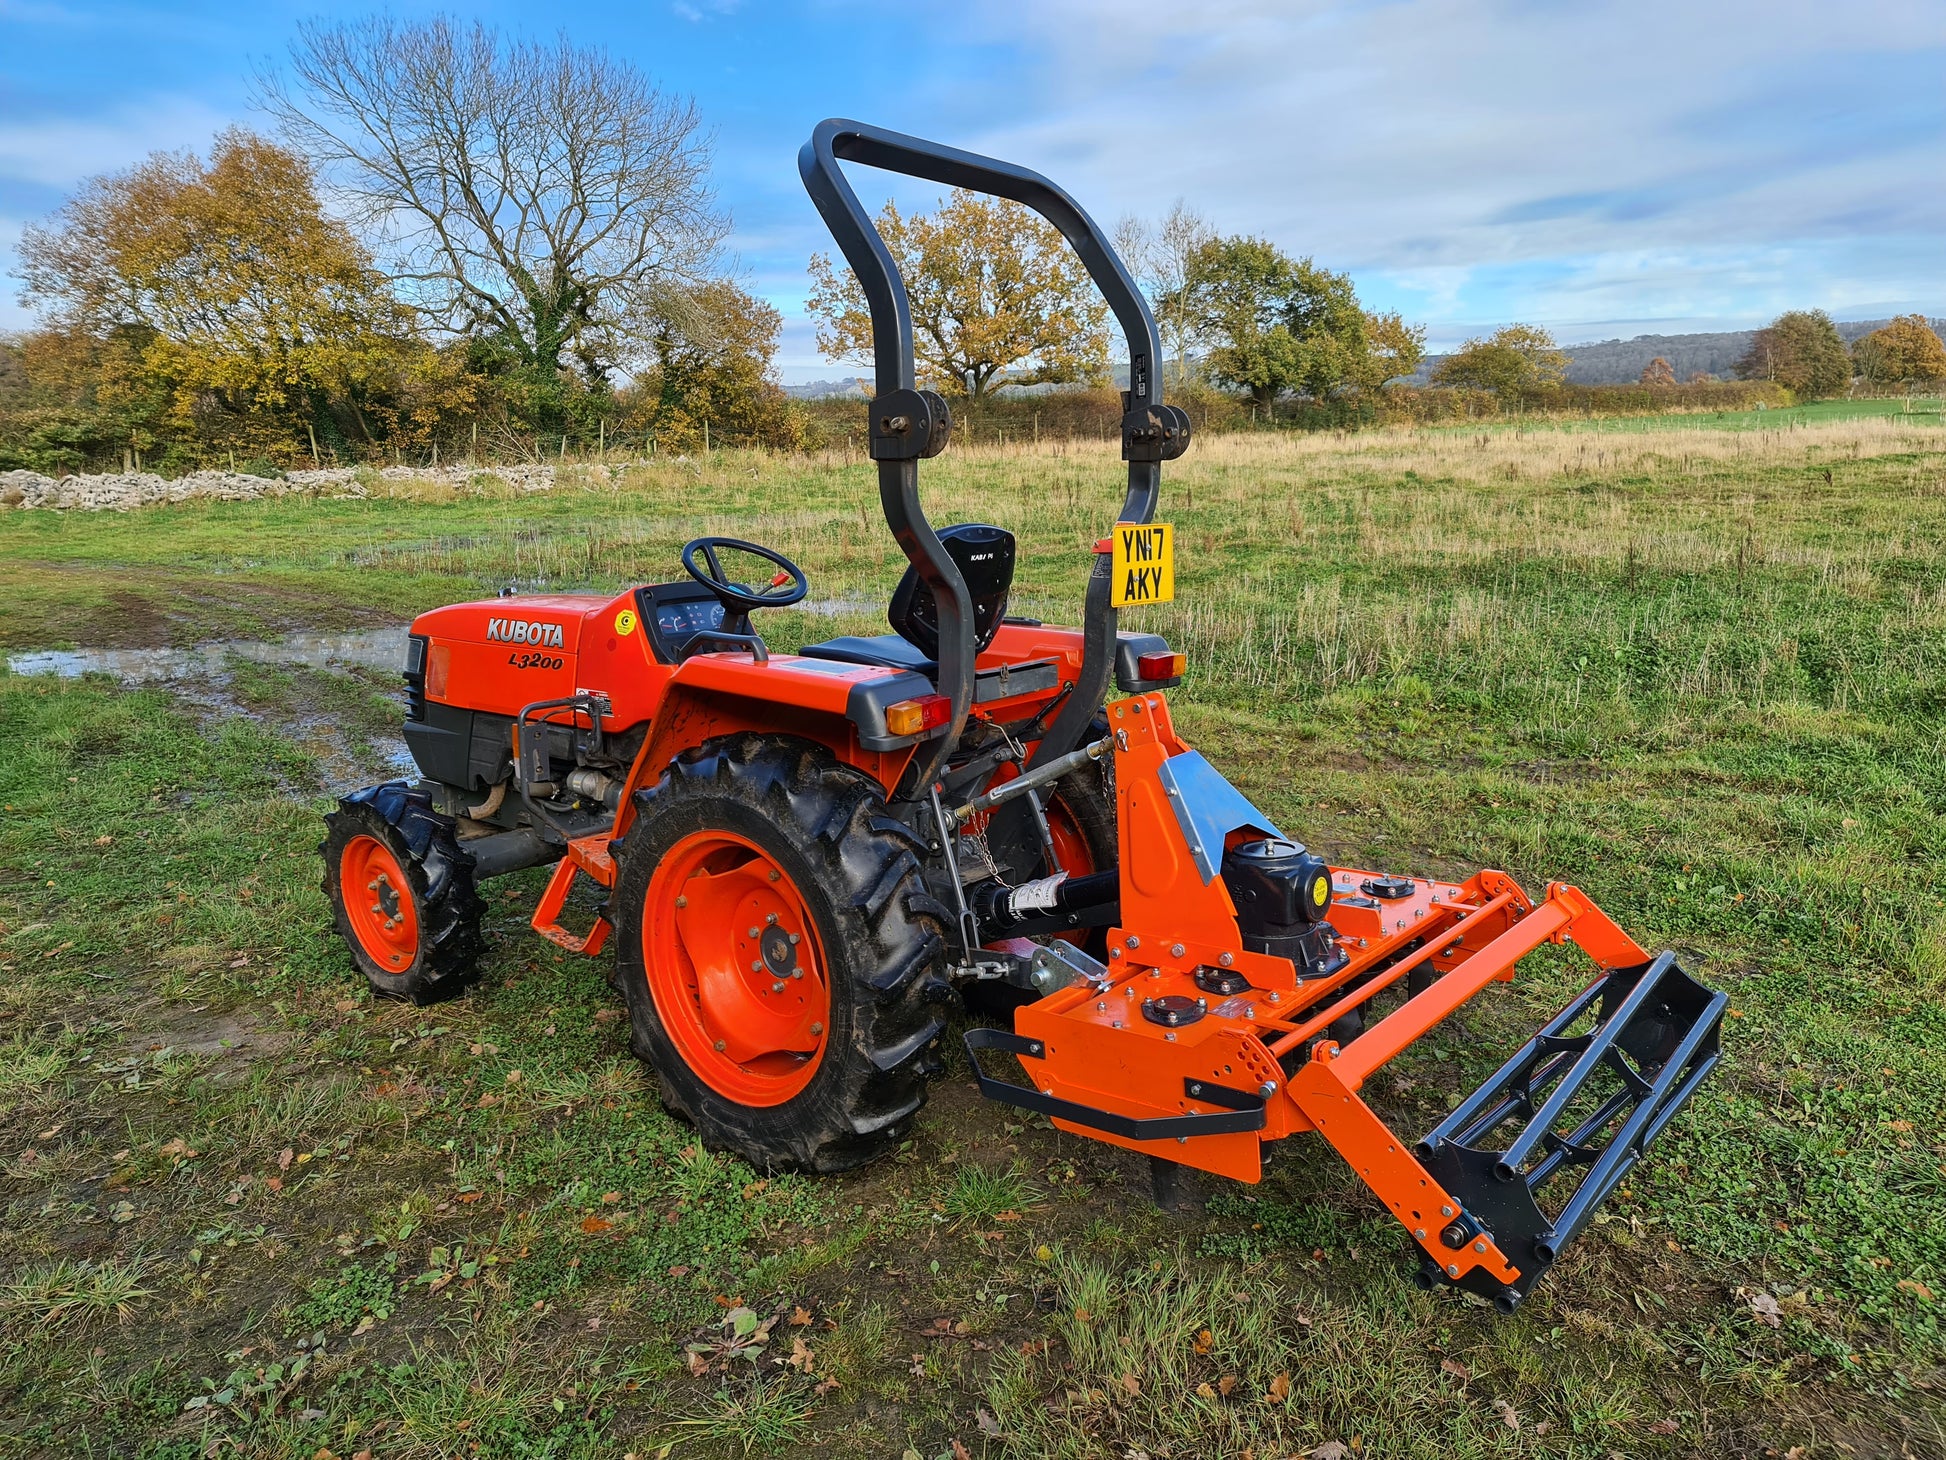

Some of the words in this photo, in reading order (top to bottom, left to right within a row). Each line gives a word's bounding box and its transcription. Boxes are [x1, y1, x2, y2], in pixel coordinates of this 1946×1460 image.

[1122, 528, 1164, 563] YN17
[1124, 566, 1162, 601] AKY
[486, 617, 564, 648] KUBOTA
[508, 652, 564, 670] L3200
